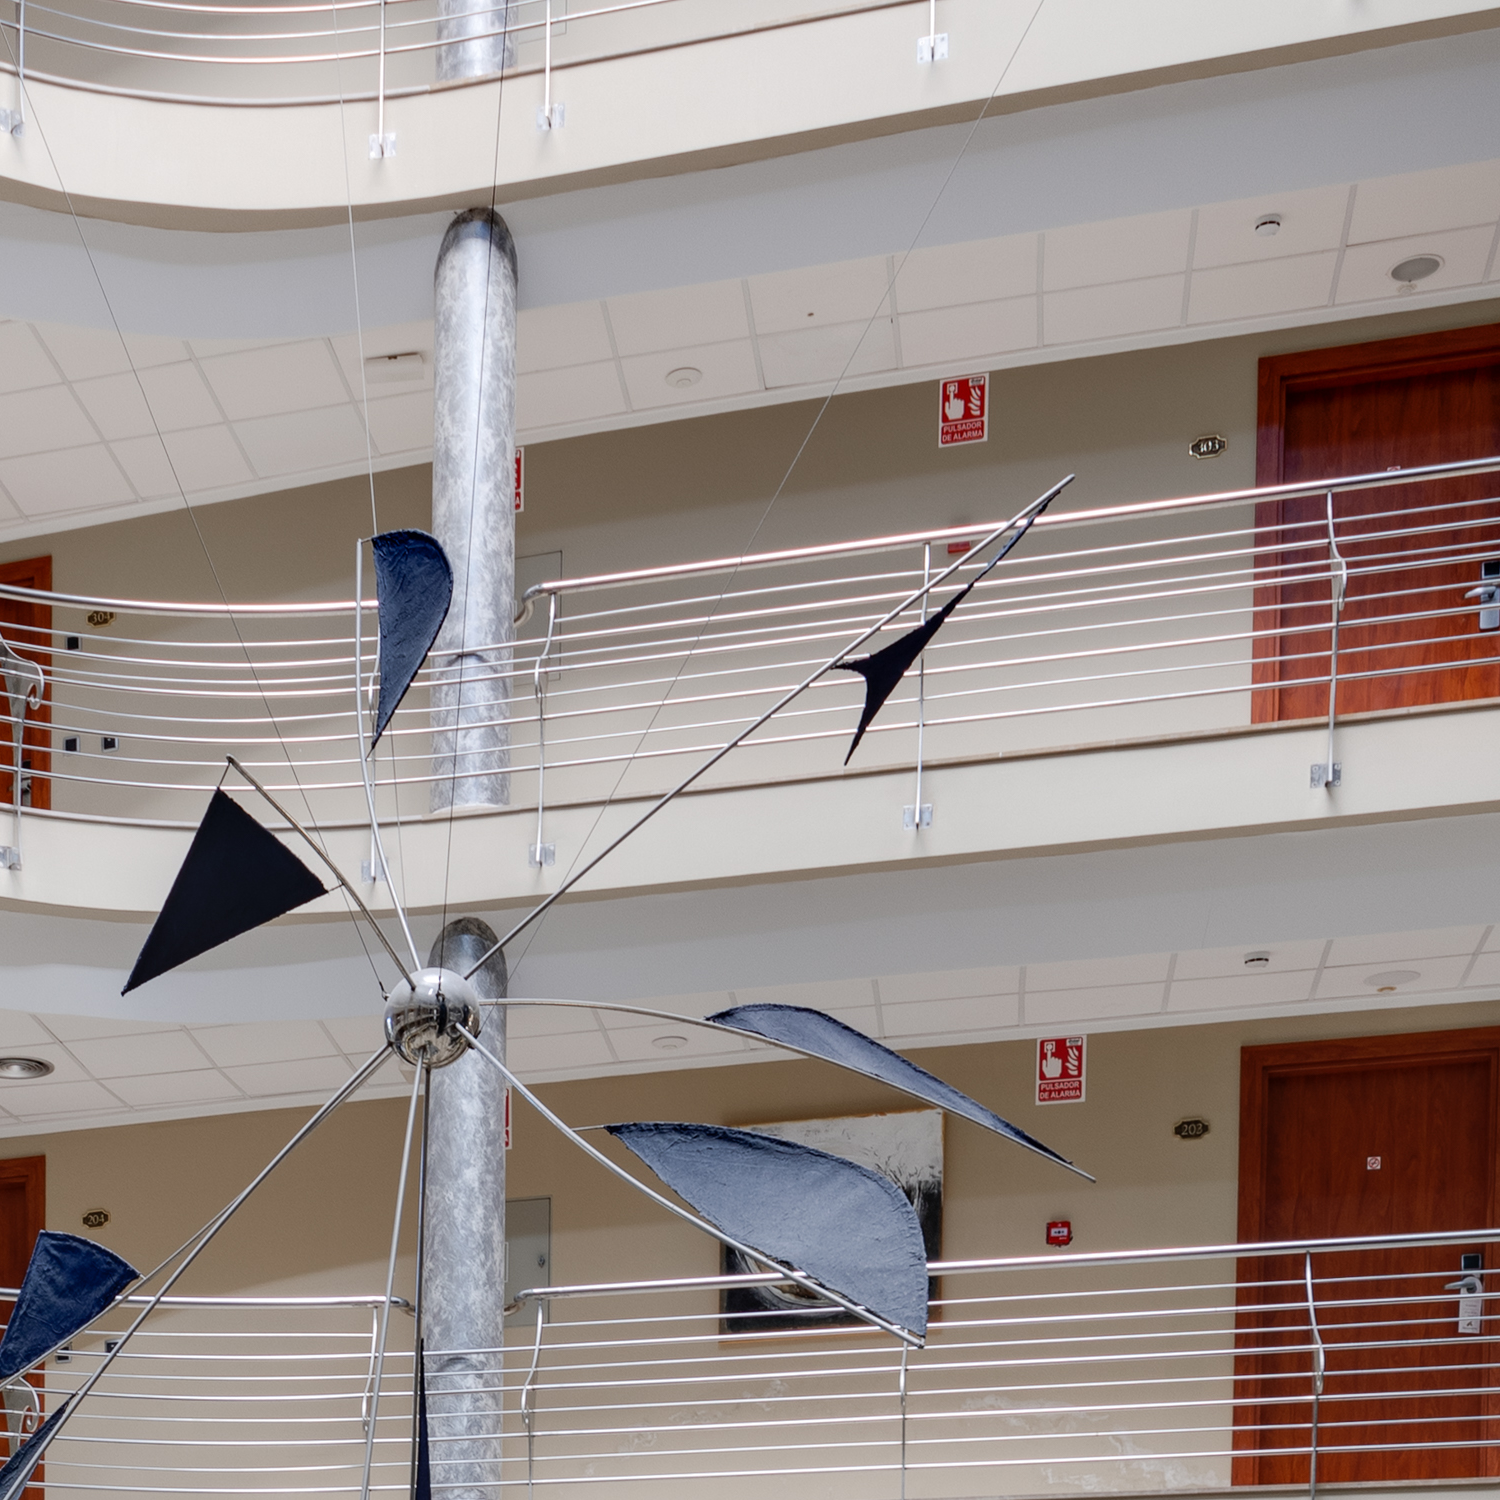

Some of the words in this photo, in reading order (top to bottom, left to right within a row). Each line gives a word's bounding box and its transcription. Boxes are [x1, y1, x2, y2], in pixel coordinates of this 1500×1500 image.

[943, 421, 982, 433] PULSADOR
[942, 434, 952, 442] DE
[953, 429, 983, 440] ALARMA
[1041, 1081, 1080, 1091] PULSADOR
[1040, 1092, 1049, 1100] DE
[1050, 1089, 1080, 1098] ALARMA
[1181, 1123, 1203, 1136] 203
[87, 1214, 105, 1225] 204
